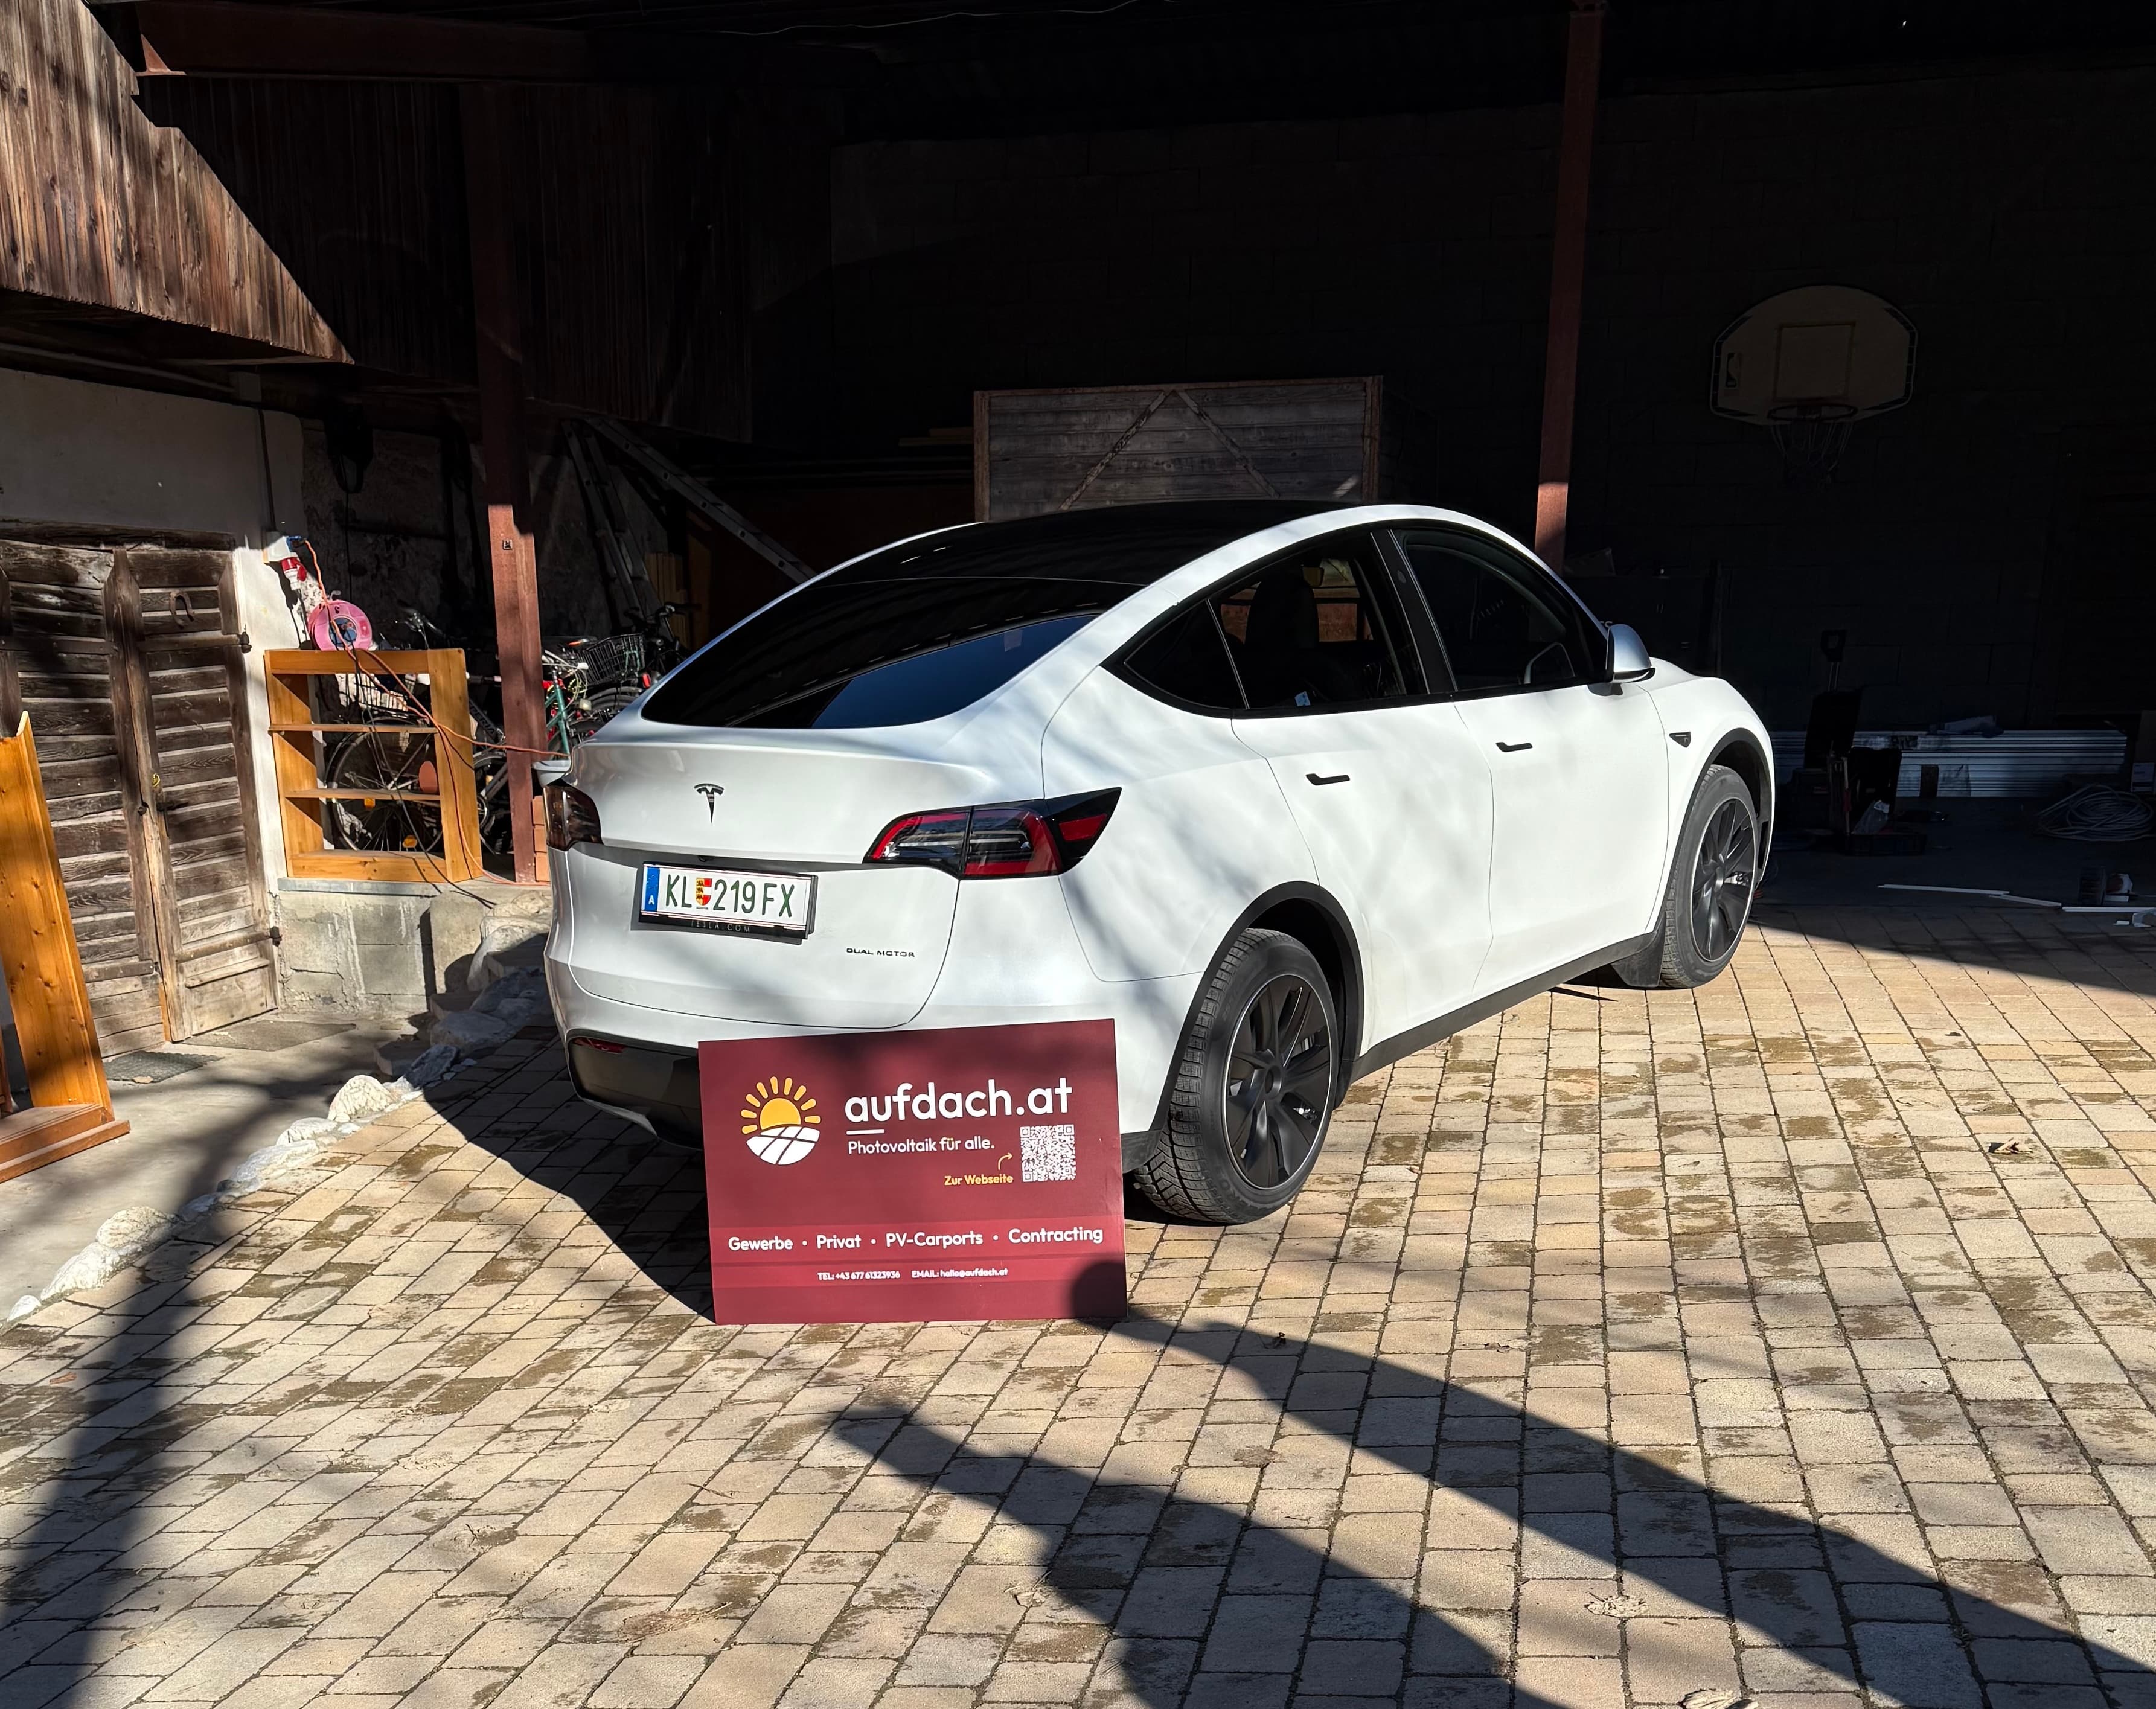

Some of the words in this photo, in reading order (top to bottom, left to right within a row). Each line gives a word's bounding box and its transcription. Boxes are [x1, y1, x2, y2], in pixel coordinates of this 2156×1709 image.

[648, 894, 655, 905] A
[665, 874, 693, 908] KL
[845, 1078, 1073, 1123] aufdach.at
[848, 1137, 937, 1155] Photovoltaik
[939, 1136, 963, 1152] für
[965, 1136, 995, 1151] alle.
[944, 1175, 962, 1186] Zur
[964, 1173, 1014, 1185] Webseite
[728, 1235, 793, 1251] Gewerbe
[817, 1234, 862, 1249] Privat
[886, 1230, 984, 1249] PV-Carports
[1008, 1226, 1104, 1245] Contracting
[817, 1271, 835, 1280] TEL:
[835, 1271, 850, 1280] +43
[850, 1271, 865, 1280] 677
[911, 1270, 939, 1279] EMAIL:
[940, 1267, 1008, 1278] hallo@aufdach.at
